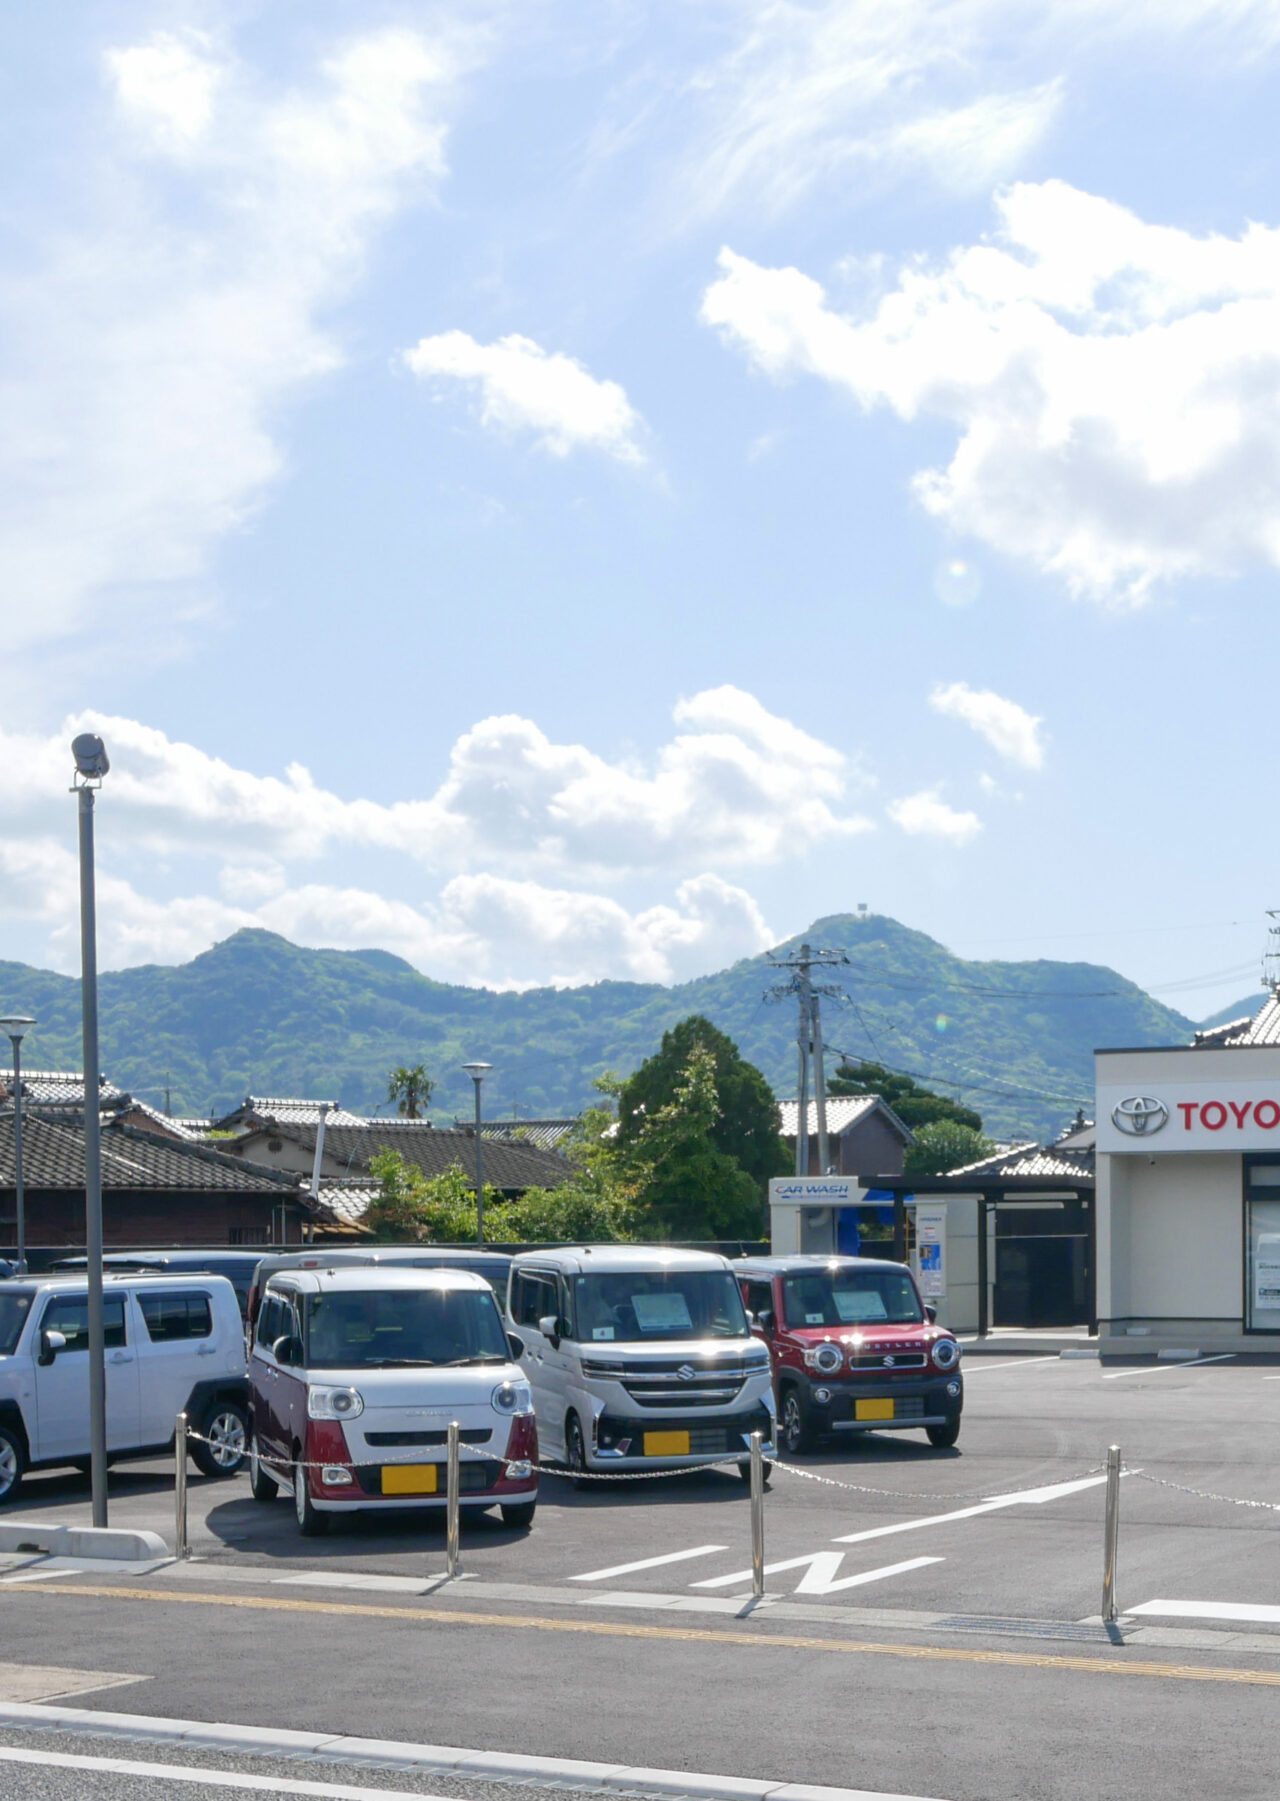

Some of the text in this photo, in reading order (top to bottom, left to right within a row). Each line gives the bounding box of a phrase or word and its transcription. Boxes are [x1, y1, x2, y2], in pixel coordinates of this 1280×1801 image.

[775, 1184, 848, 1194] CAR WASH
[854, 1341, 922, 1350] USTLER
[567, 1545, 946, 1595] IN
